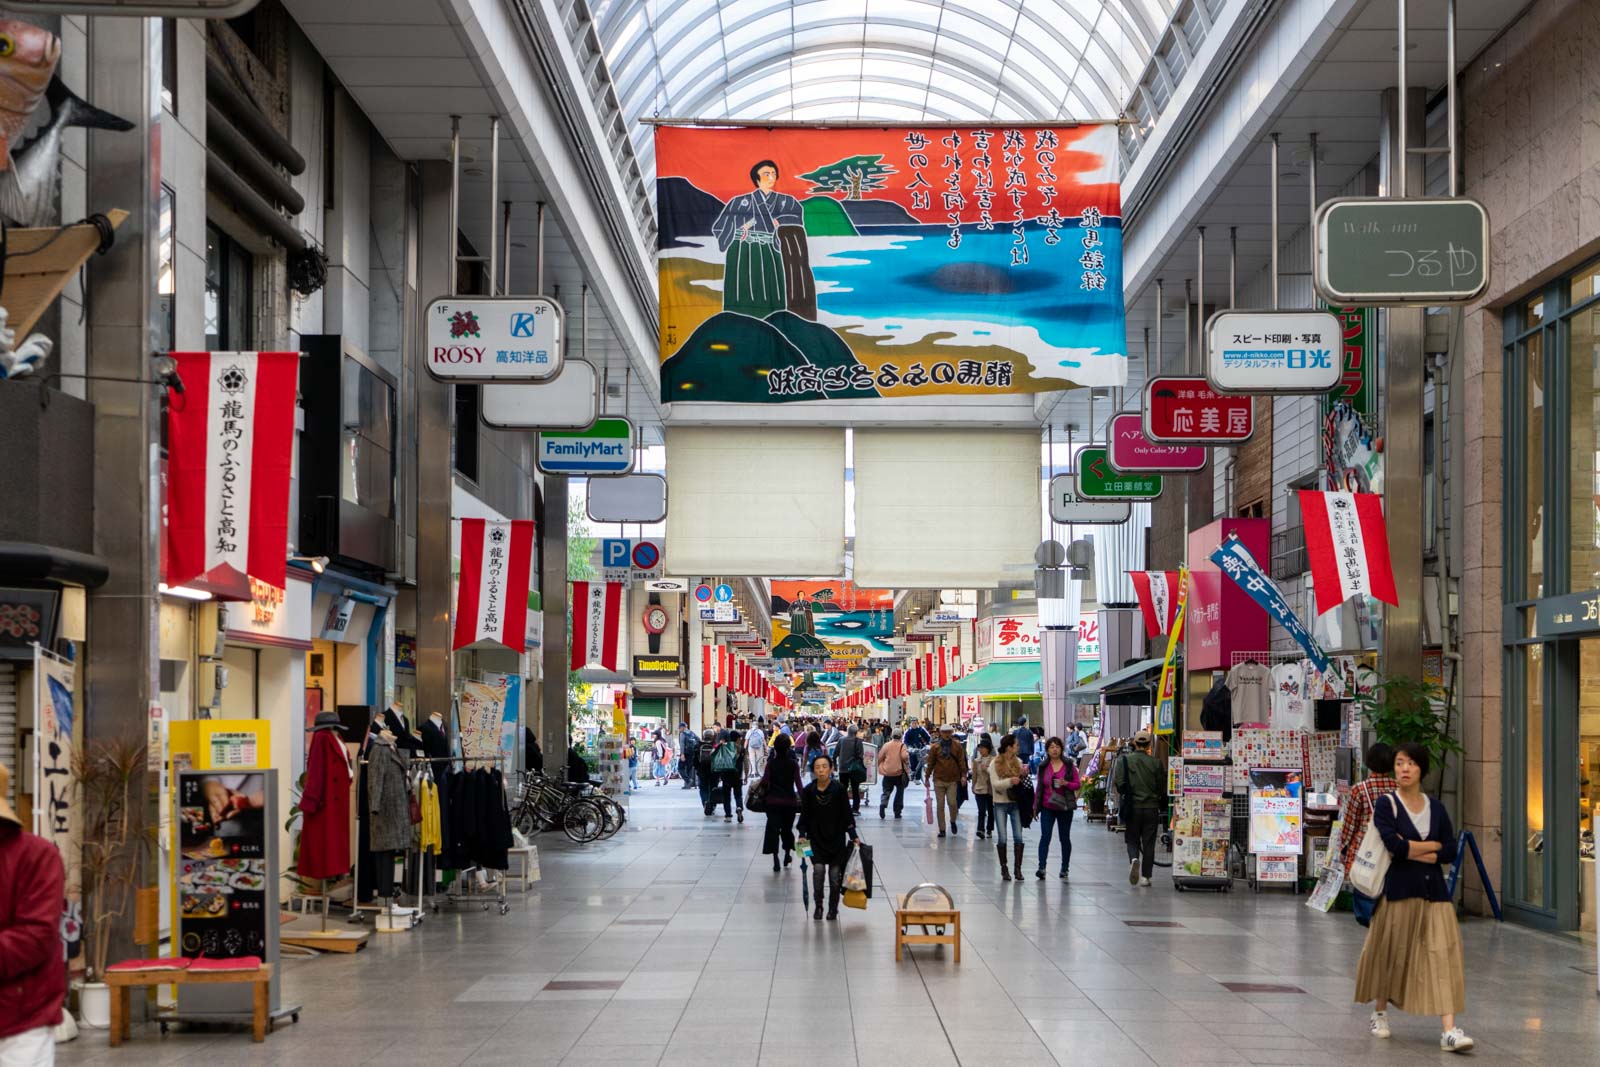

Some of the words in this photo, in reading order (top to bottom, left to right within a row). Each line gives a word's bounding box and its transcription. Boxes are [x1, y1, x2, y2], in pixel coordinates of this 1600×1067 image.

[1384, 241, 1477, 288] つるや
[437, 306, 449, 314] 1F
[535, 306, 548, 315] 2F
[1233, 334, 1322, 344] スピード印刷・写真
[433, 346, 487, 364] ROSY
[496, 350, 548, 364] 高知洋品
[1224, 351, 1284, 359] www.d-nikko.com
[1224, 359, 1285, 369] デジタルフォト
[1287, 349, 1332, 369] 日光
[1172, 407, 1249, 434] 応美屋
[1121, 430, 1144, 440] ヘア
[546, 440, 623, 458] FamilyMart
[1134, 447, 1148, 455] Only
[1150, 446, 1167, 454] Color
[216, 399, 244, 554] 龍馬のふるさと高知
[1104, 481, 1153, 491] 立田薬師堂
[609, 541, 626, 565] P
[483, 547, 504, 633] 龍馬のふるさと高知
[462, 698, 480, 756] ホットサンド
